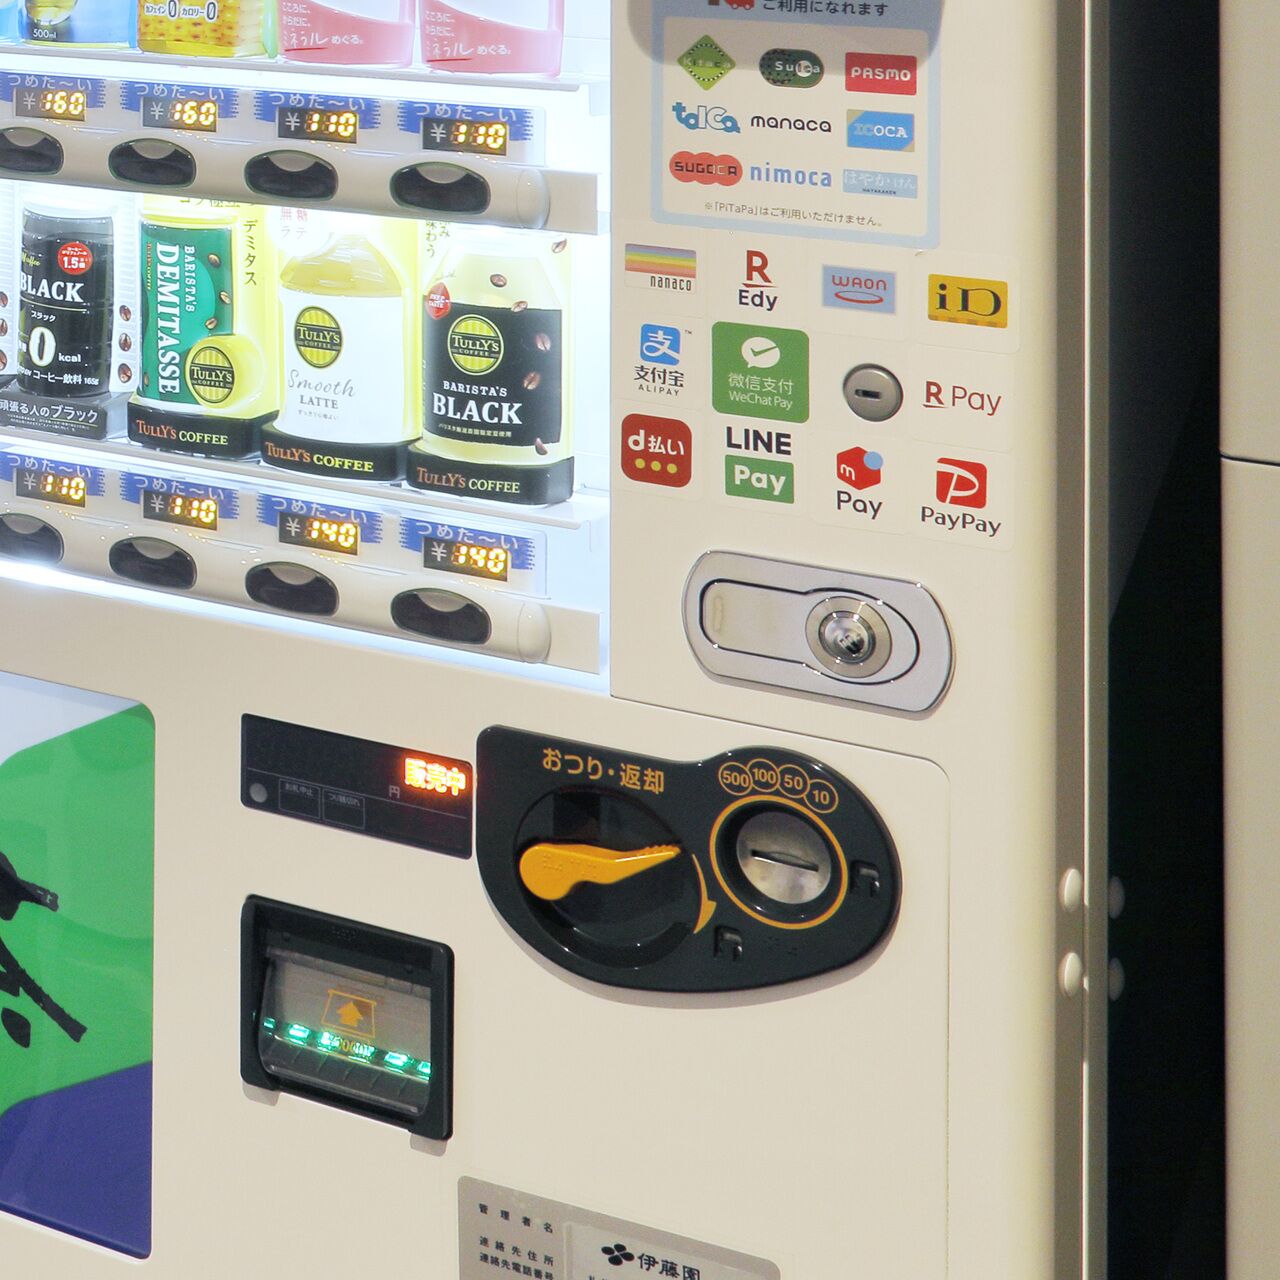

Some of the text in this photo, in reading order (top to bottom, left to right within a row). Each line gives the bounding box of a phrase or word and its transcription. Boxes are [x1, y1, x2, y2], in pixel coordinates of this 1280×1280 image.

[32, 28, 57, 40] 500ml
[851, 66, 911, 80] PASMO
[750, 116, 832, 132] manaca
[854, 123, 908, 138] ICOCA
[750, 162, 832, 187] nimoca
[844, 172, 916, 189] はやかけん
[243, 218, 259, 286] デミタス
[650, 274, 692, 293] nanaco
[738, 289, 777, 312] Edy
[936, 282, 1002, 317] iD
[155, 241, 182, 395] DEMITASSE
[58, 352, 82, 363] kcal
[288, 369, 356, 399] Smooth
[634, 365, 685, 389] 支付宝
[728, 373, 794, 394] 微信支付
[637, 385, 681, 397] ALIPAY
[729, 390, 793, 411] WeChat Pay
[0, 398, 98, 424] 頑張る人のブラック
[299, 395, 339, 410] LATTE
[727, 426, 792, 455] LINE
[734, 464, 786, 496] Pay
[837, 489, 883, 520] Pay
[921, 504, 1002, 537] PayPay
[404, 756, 467, 796] 販売中
[543, 749, 664, 796] おつり・返却
[722, 769, 750, 788] 500
[752, 767, 778, 785] 100
[783, 774, 803, 792] 50
[812, 789, 830, 806] 10
